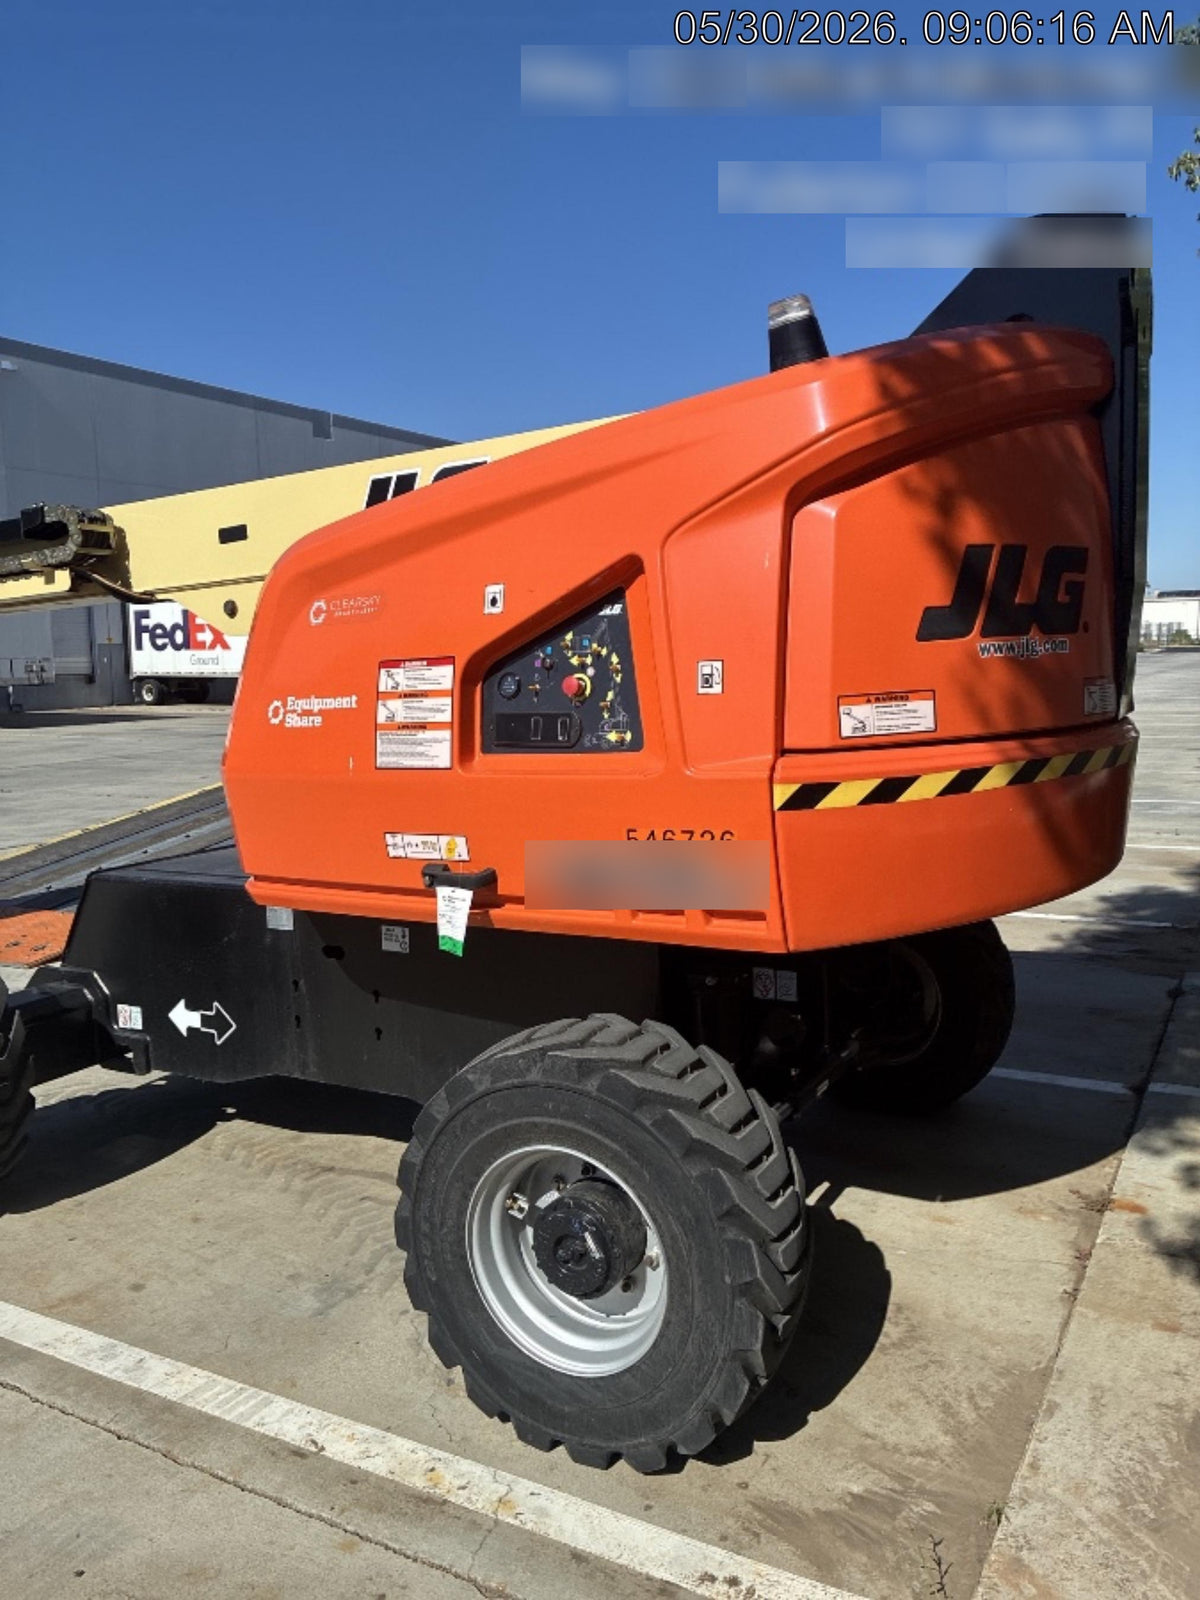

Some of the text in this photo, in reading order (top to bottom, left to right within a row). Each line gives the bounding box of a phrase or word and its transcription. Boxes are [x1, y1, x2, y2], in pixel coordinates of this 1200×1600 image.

[916, 544, 1088, 642] JLG
[978, 636, 1069, 658] www.jlg.com
[286, 695, 357, 712] Equipment
[285, 713, 322, 727] Share
